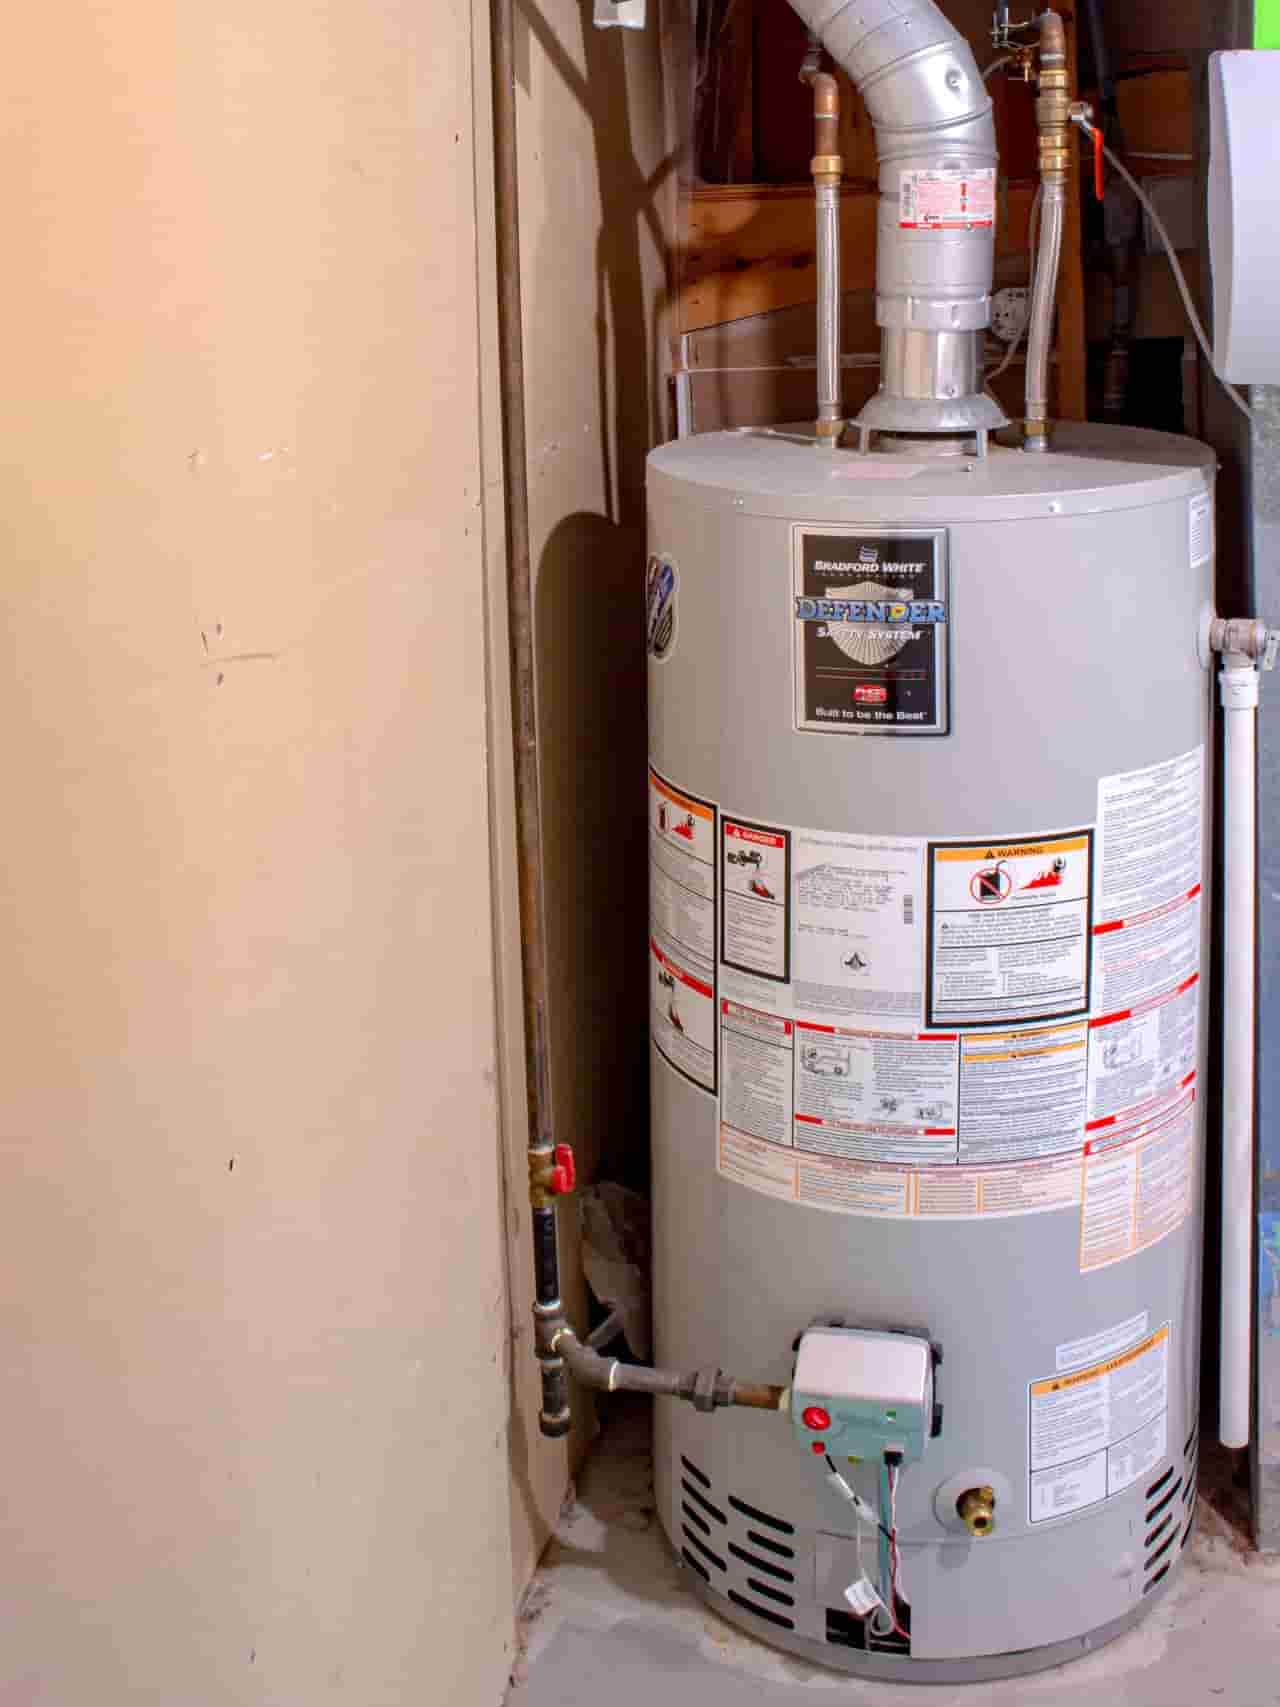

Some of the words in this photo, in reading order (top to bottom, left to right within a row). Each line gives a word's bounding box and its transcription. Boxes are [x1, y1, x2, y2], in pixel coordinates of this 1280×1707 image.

[815, 560, 879, 573] BRADFORD
[796, 598, 946, 623] DEFENDER
[874, 711, 893, 720] the
[998, 847, 1044, 857] WARNING
